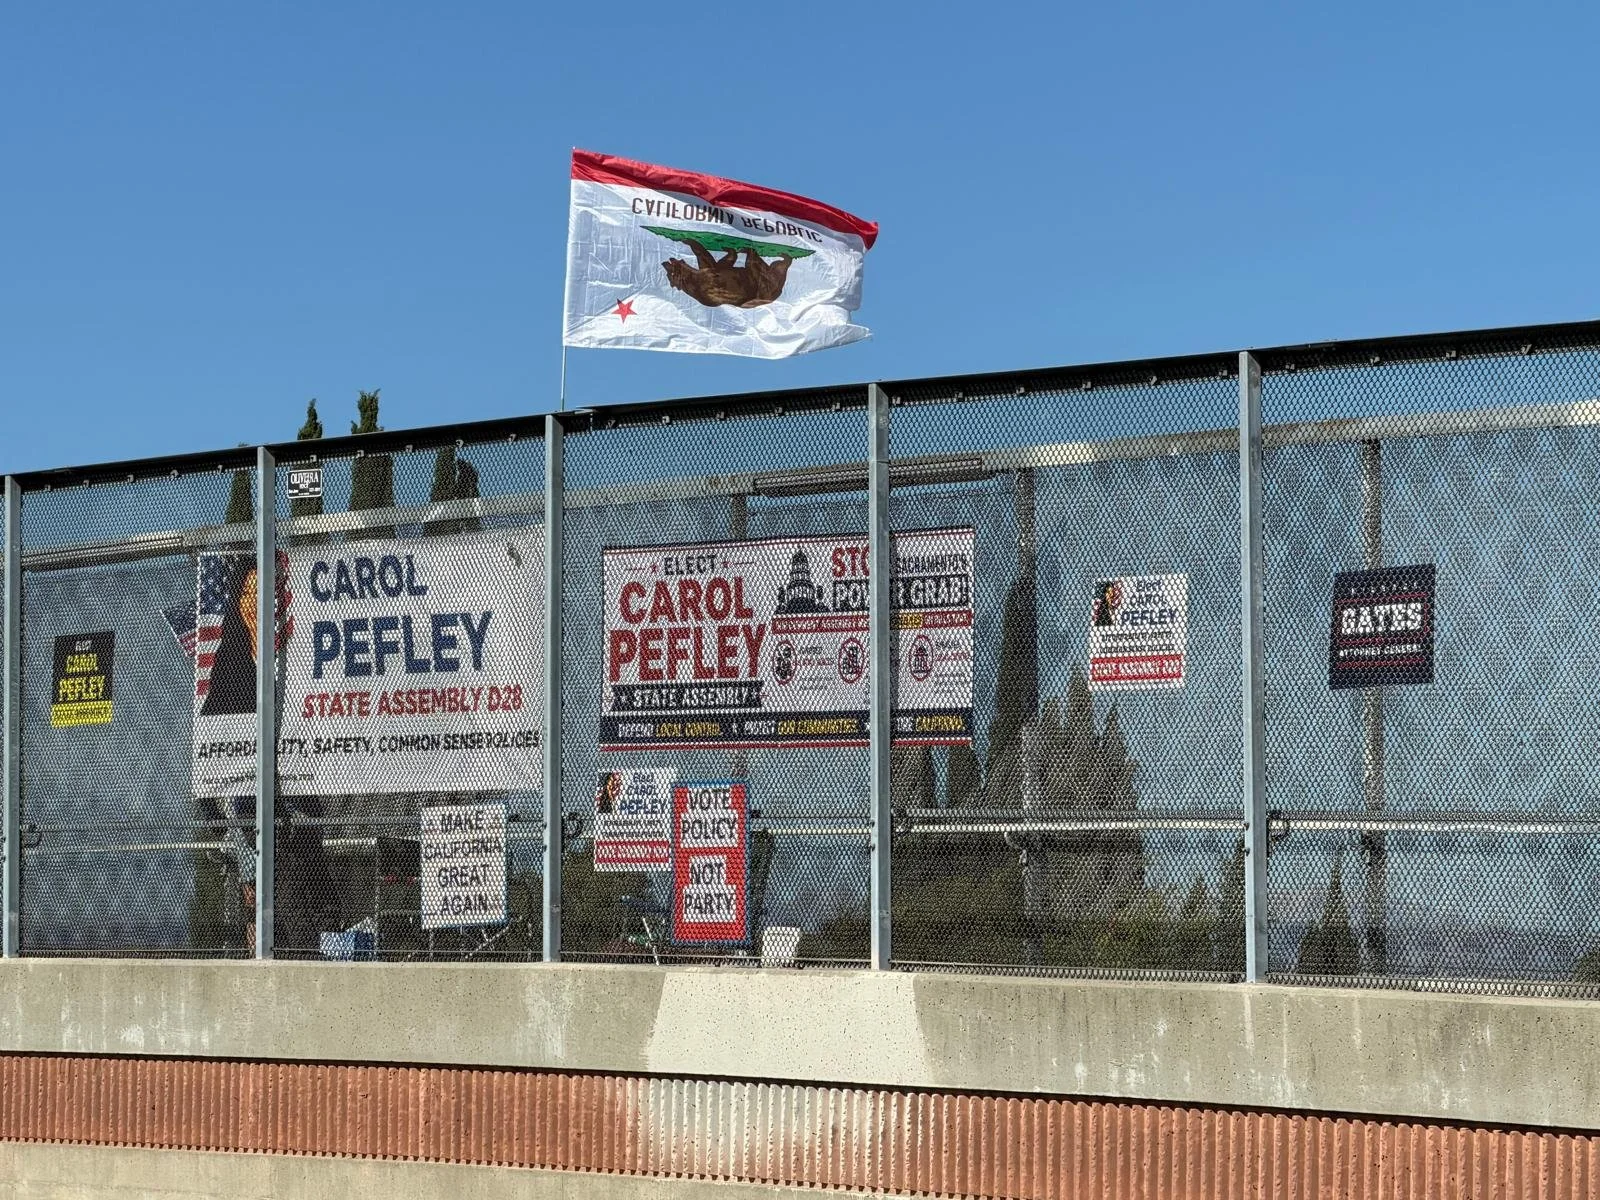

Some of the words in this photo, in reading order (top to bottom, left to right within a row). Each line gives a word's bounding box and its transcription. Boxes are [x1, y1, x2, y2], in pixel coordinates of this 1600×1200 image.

[664, 554, 717, 576] ELECT
[310, 555, 429, 603] CAROL
[619, 576, 754, 624] CAROL
[1121, 608, 1178, 626] PEFLEY
[1341, 602, 1422, 634] GATES
[312, 611, 494, 680] PEFLEY
[609, 623, 766, 682] PEFLEY
[303, 691, 371, 719] STATE
[377, 686, 484, 716] ASSEMBLY
[487, 684, 524, 711] D28
[633, 687, 677, 708] STATE
[681, 684, 750, 706] ASSEMBLY
[379, 734, 441, 753] COMMON
[442, 732, 484, 750] SENSE
[687, 788, 730, 812] VOTE
[440, 810, 485, 834] MAKE
[681, 816, 737, 841] POLICY
[437, 864, 491, 889] GREAT
[690, 862, 724, 886] NOT
[440, 893, 489, 917] AGAIN
[683, 892, 734, 916] PARTY
